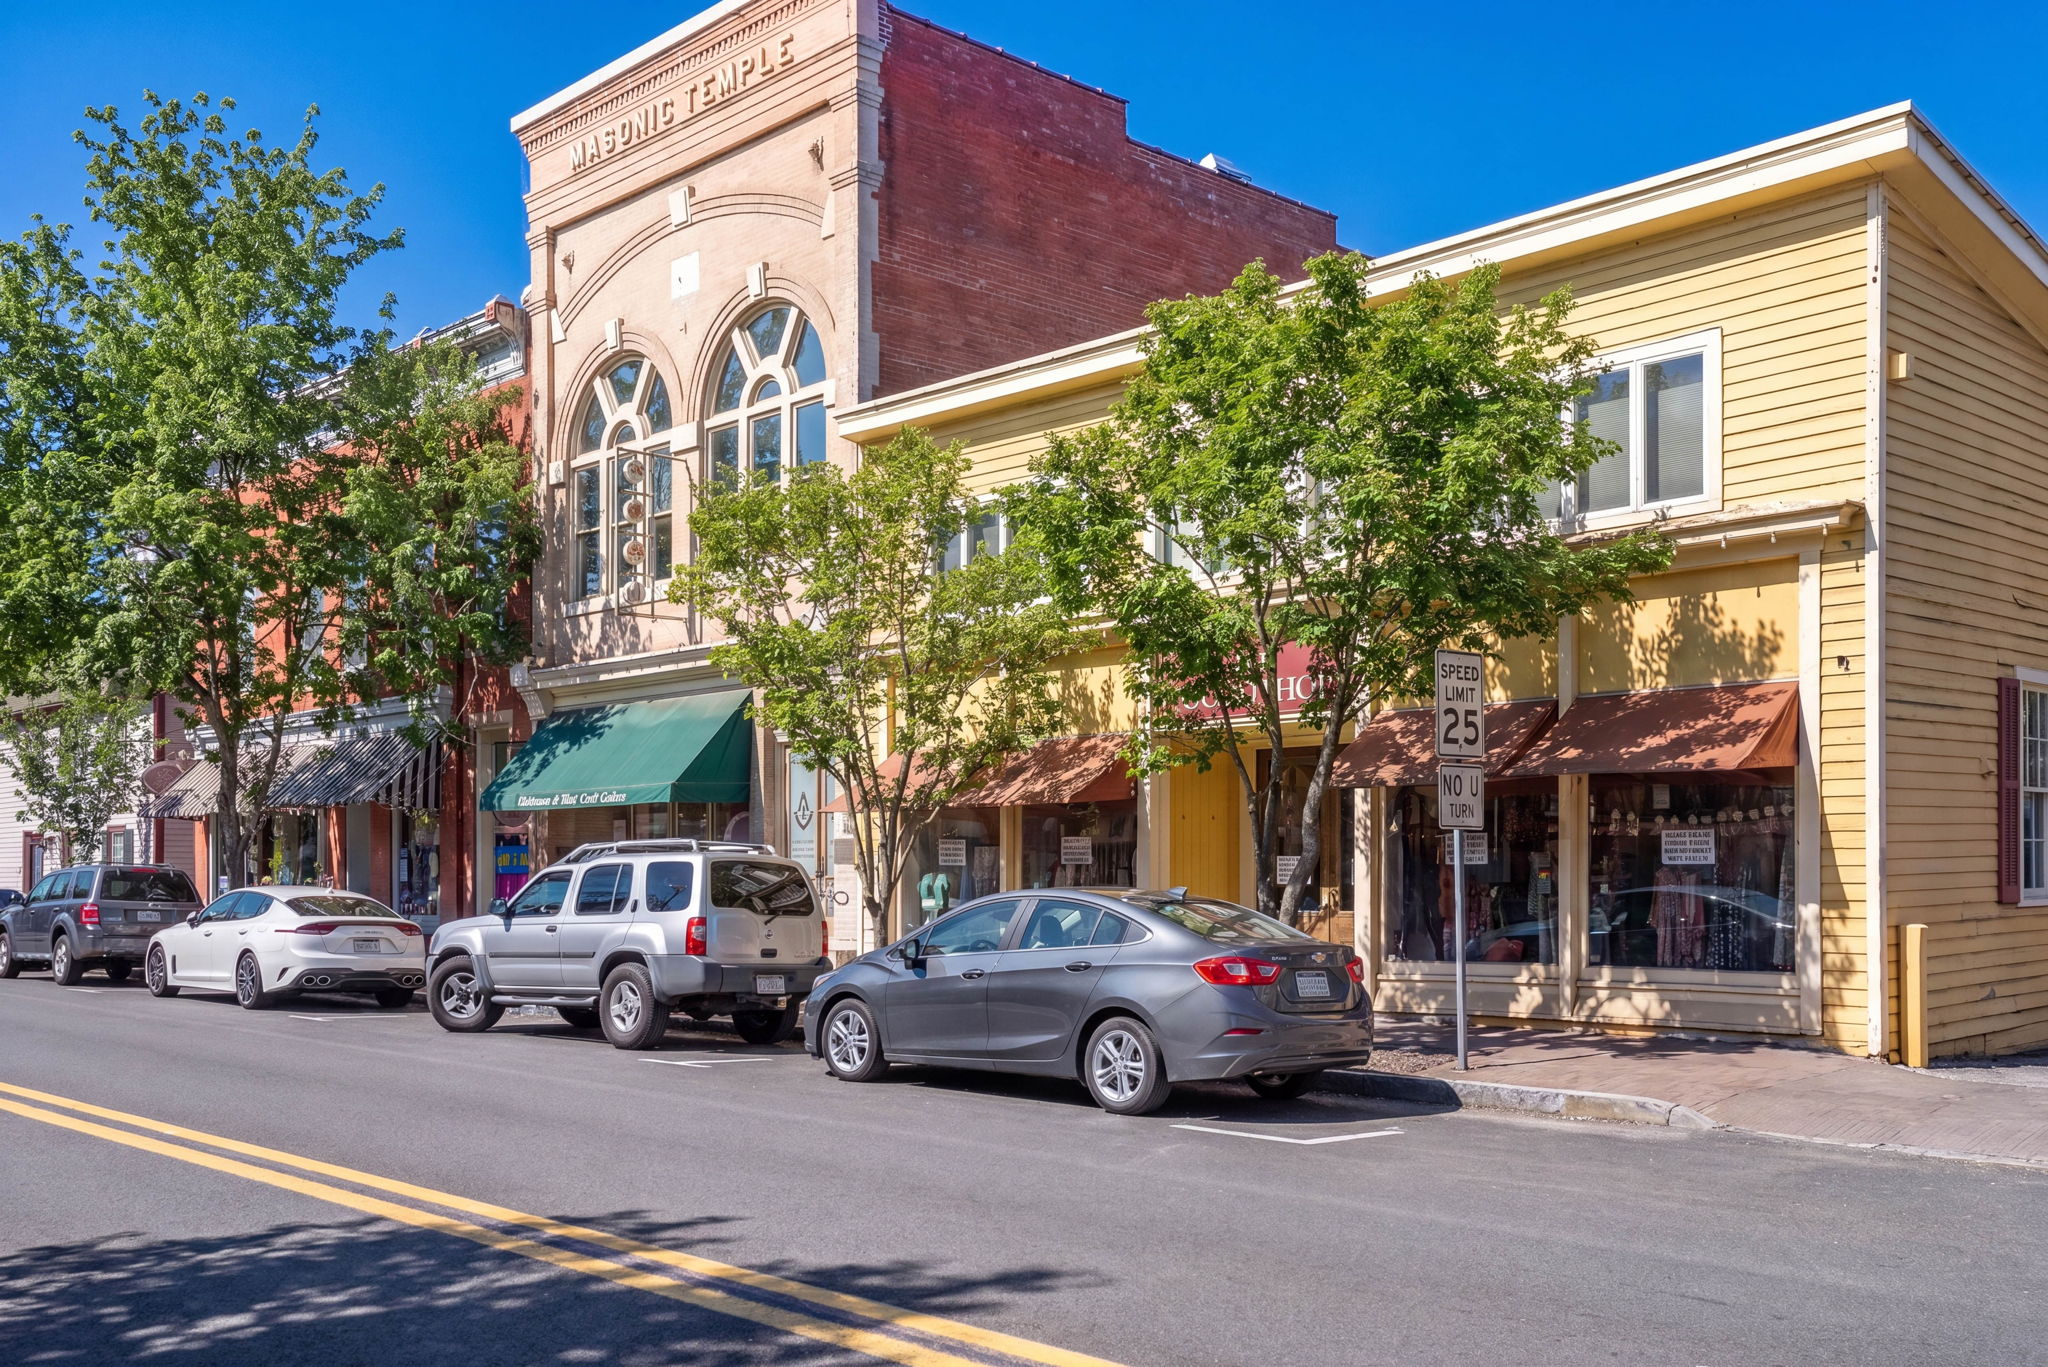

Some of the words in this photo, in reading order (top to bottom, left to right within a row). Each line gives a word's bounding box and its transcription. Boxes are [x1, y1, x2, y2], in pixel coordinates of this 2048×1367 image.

[569, 97, 674, 172] MASONIC
[684, 32, 794, 114] TEMPLE
[1440, 662, 1480, 682] SPEED
[1445, 685, 1476, 703] LIMIT
[1443, 707, 1480, 746] 25
[1443, 774, 1463, 797] NO
[1470, 775, 1479, 798] U
[1449, 803, 1475, 819] TURN
